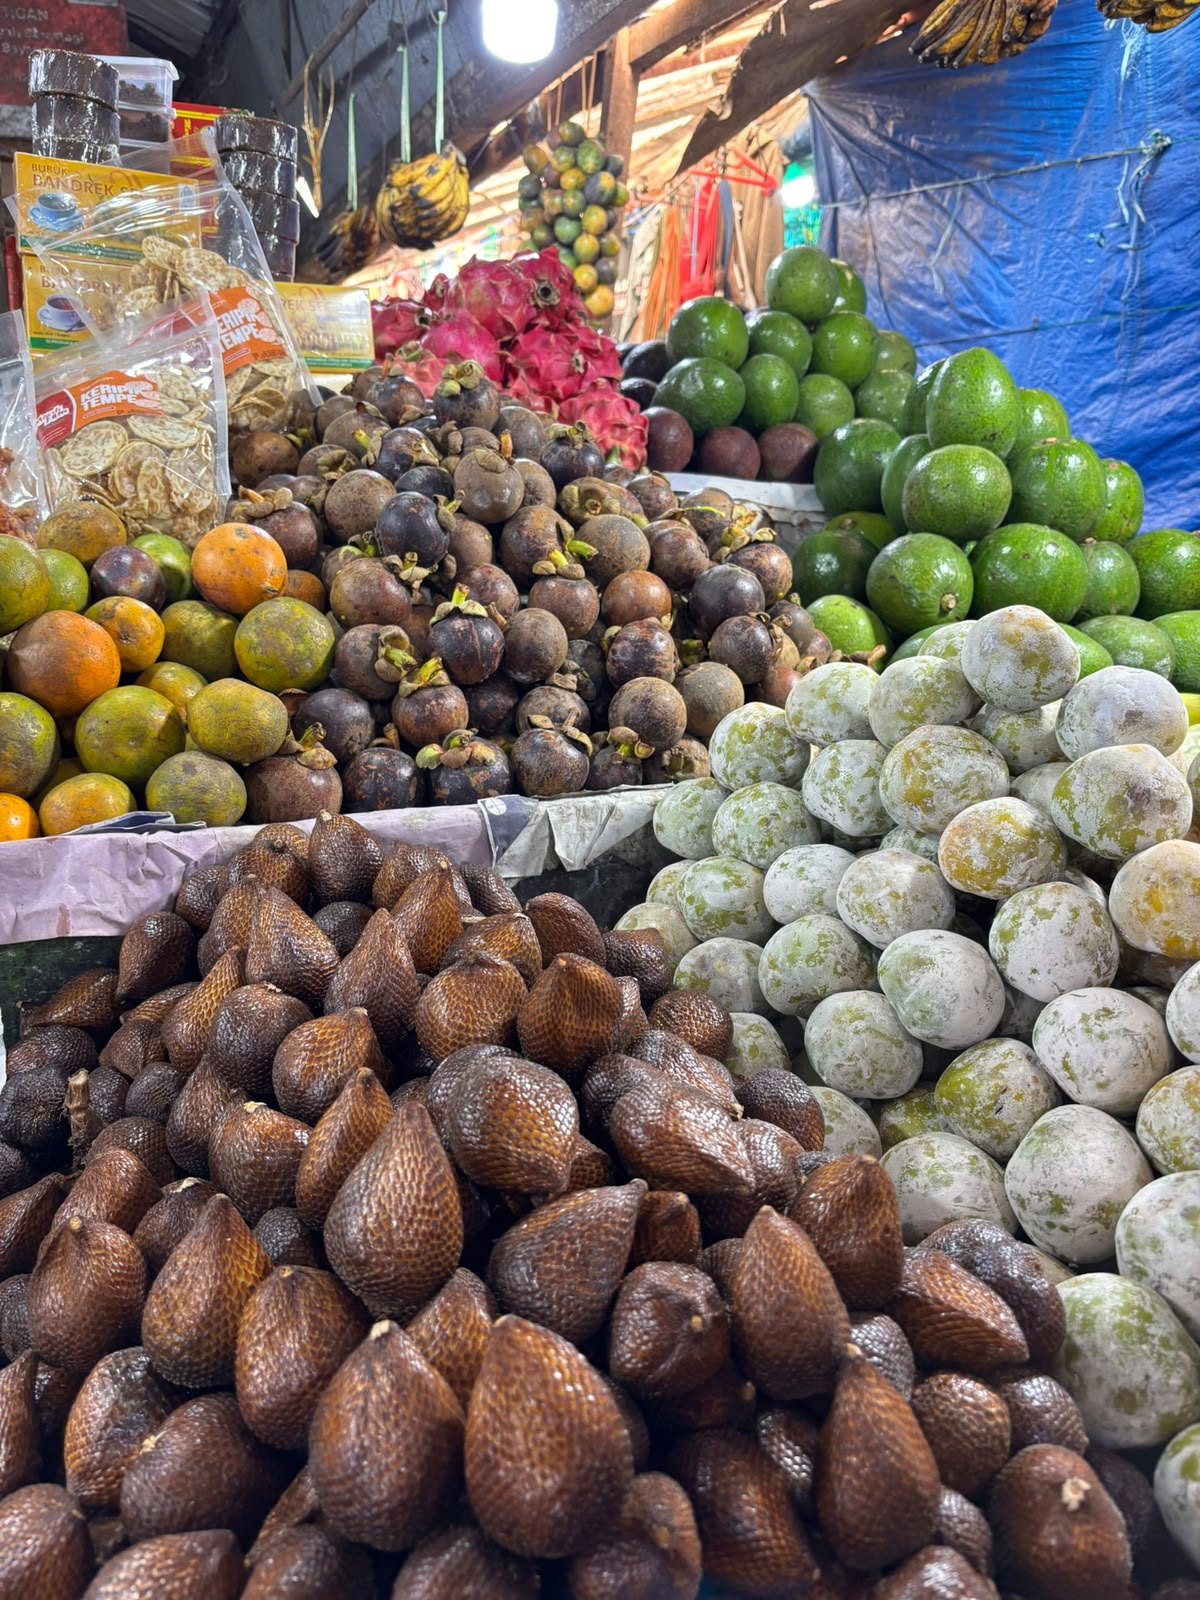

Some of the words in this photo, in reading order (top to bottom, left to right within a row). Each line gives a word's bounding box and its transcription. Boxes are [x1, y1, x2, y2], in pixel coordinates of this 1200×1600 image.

[31, 163, 69, 176] BUBUK
[32, 174, 114, 197] BANDREK
[81, 393, 138, 411] TEMPE
